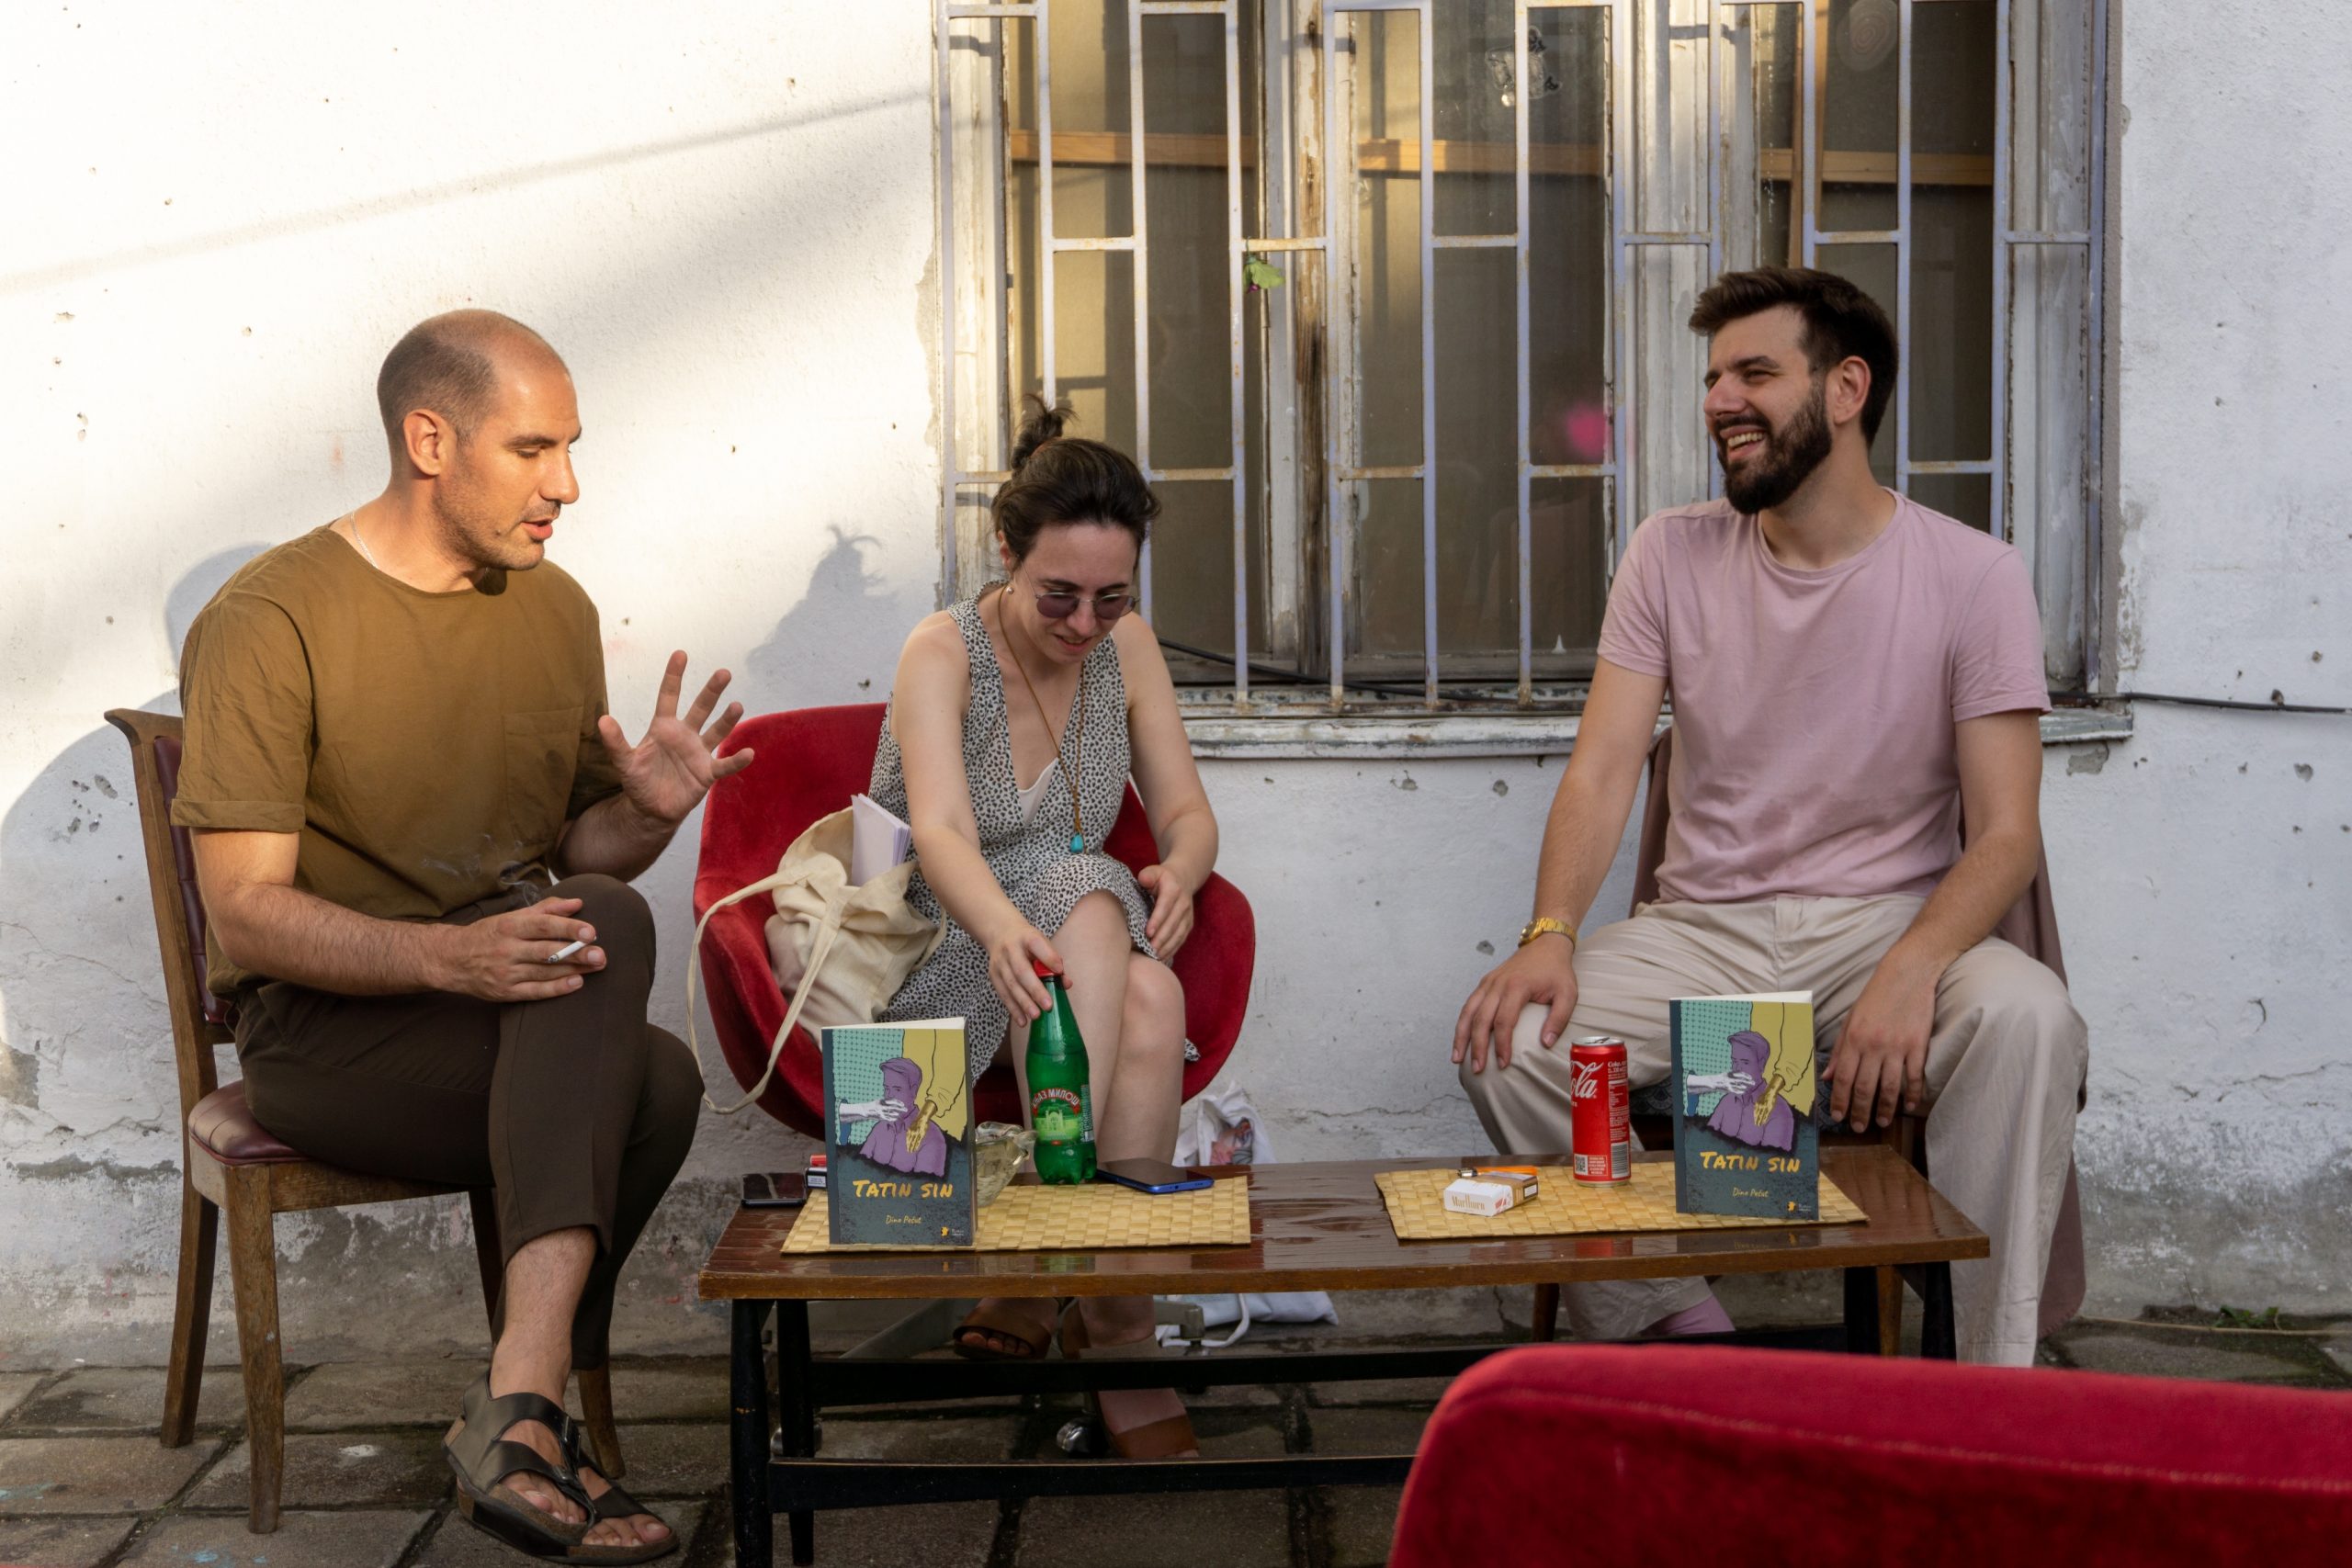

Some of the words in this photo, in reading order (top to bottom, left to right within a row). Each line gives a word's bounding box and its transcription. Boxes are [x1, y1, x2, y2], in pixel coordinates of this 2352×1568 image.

[1048, 1089, 1080, 1106] МИЛОШ
[1700, 1151, 1759, 1170] TATIN
[1768, 1156, 1801, 1173] SIN
[852, 1179, 912, 1198] TATIN
[920, 1182, 954, 1199] SIN
